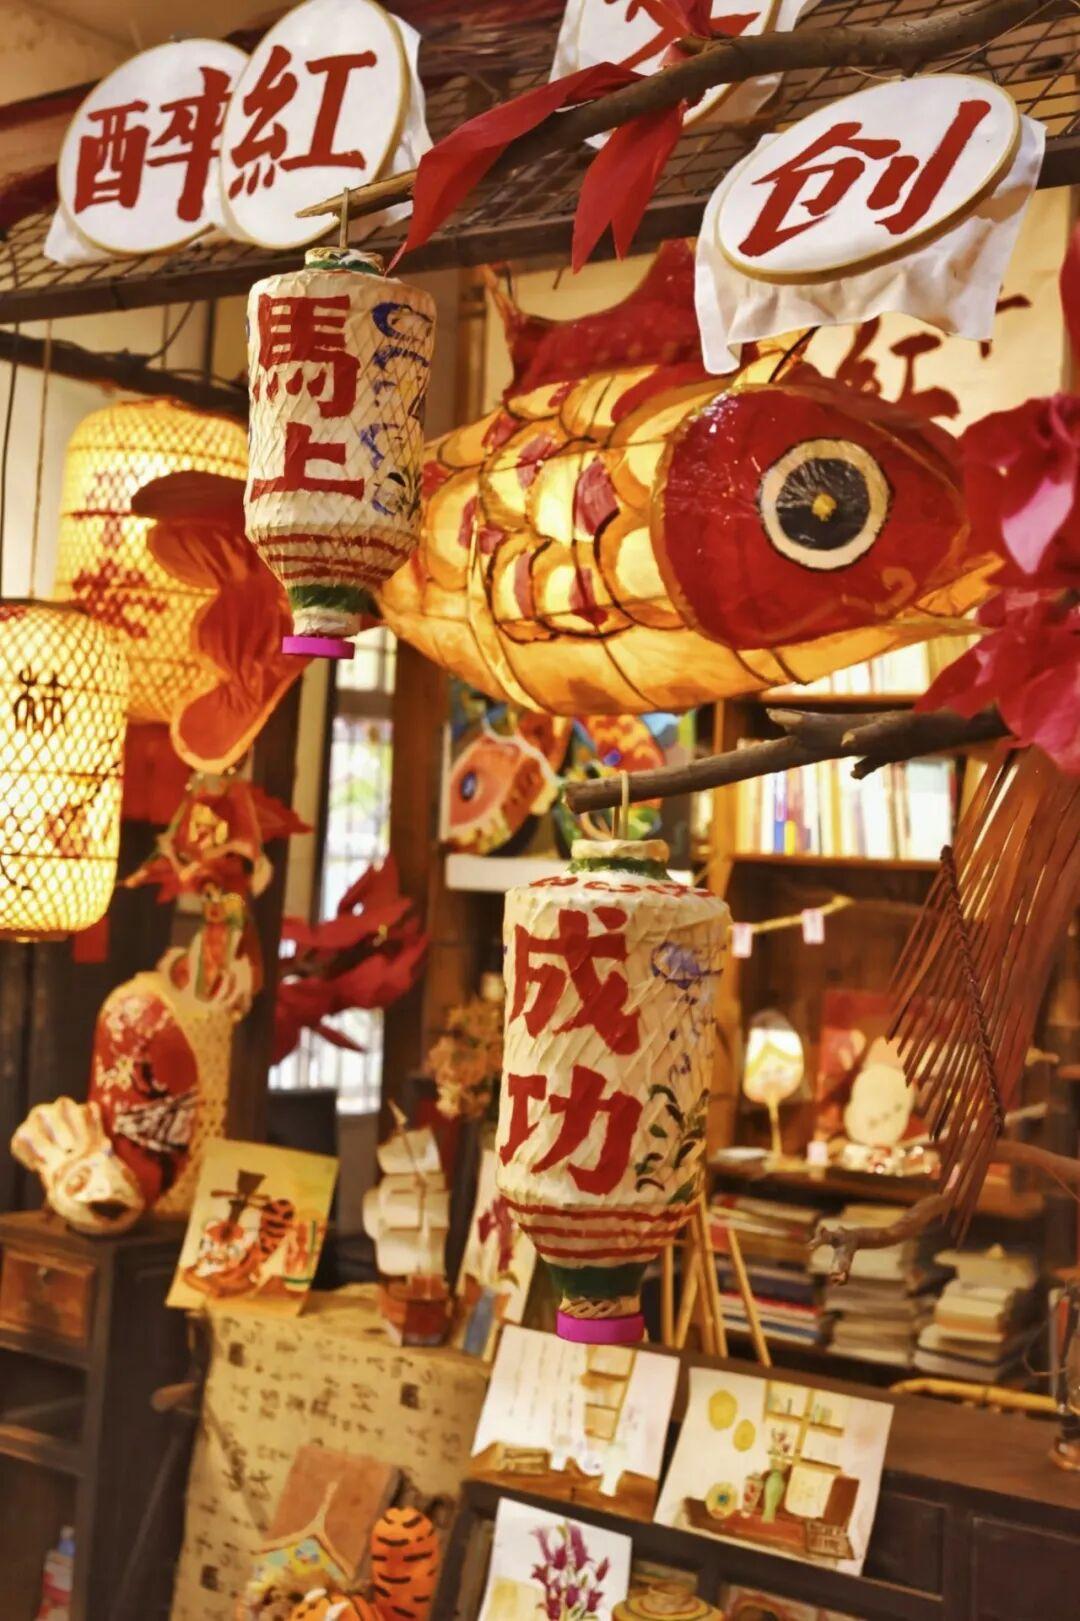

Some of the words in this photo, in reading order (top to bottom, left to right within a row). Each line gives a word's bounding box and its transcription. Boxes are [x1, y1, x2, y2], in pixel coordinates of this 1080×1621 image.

[73, 66, 234, 222] 醉
[228, 44, 378, 200] 紅
[250, 293, 365, 502] 馬上
[499, 906, 642, 1196] 成功
